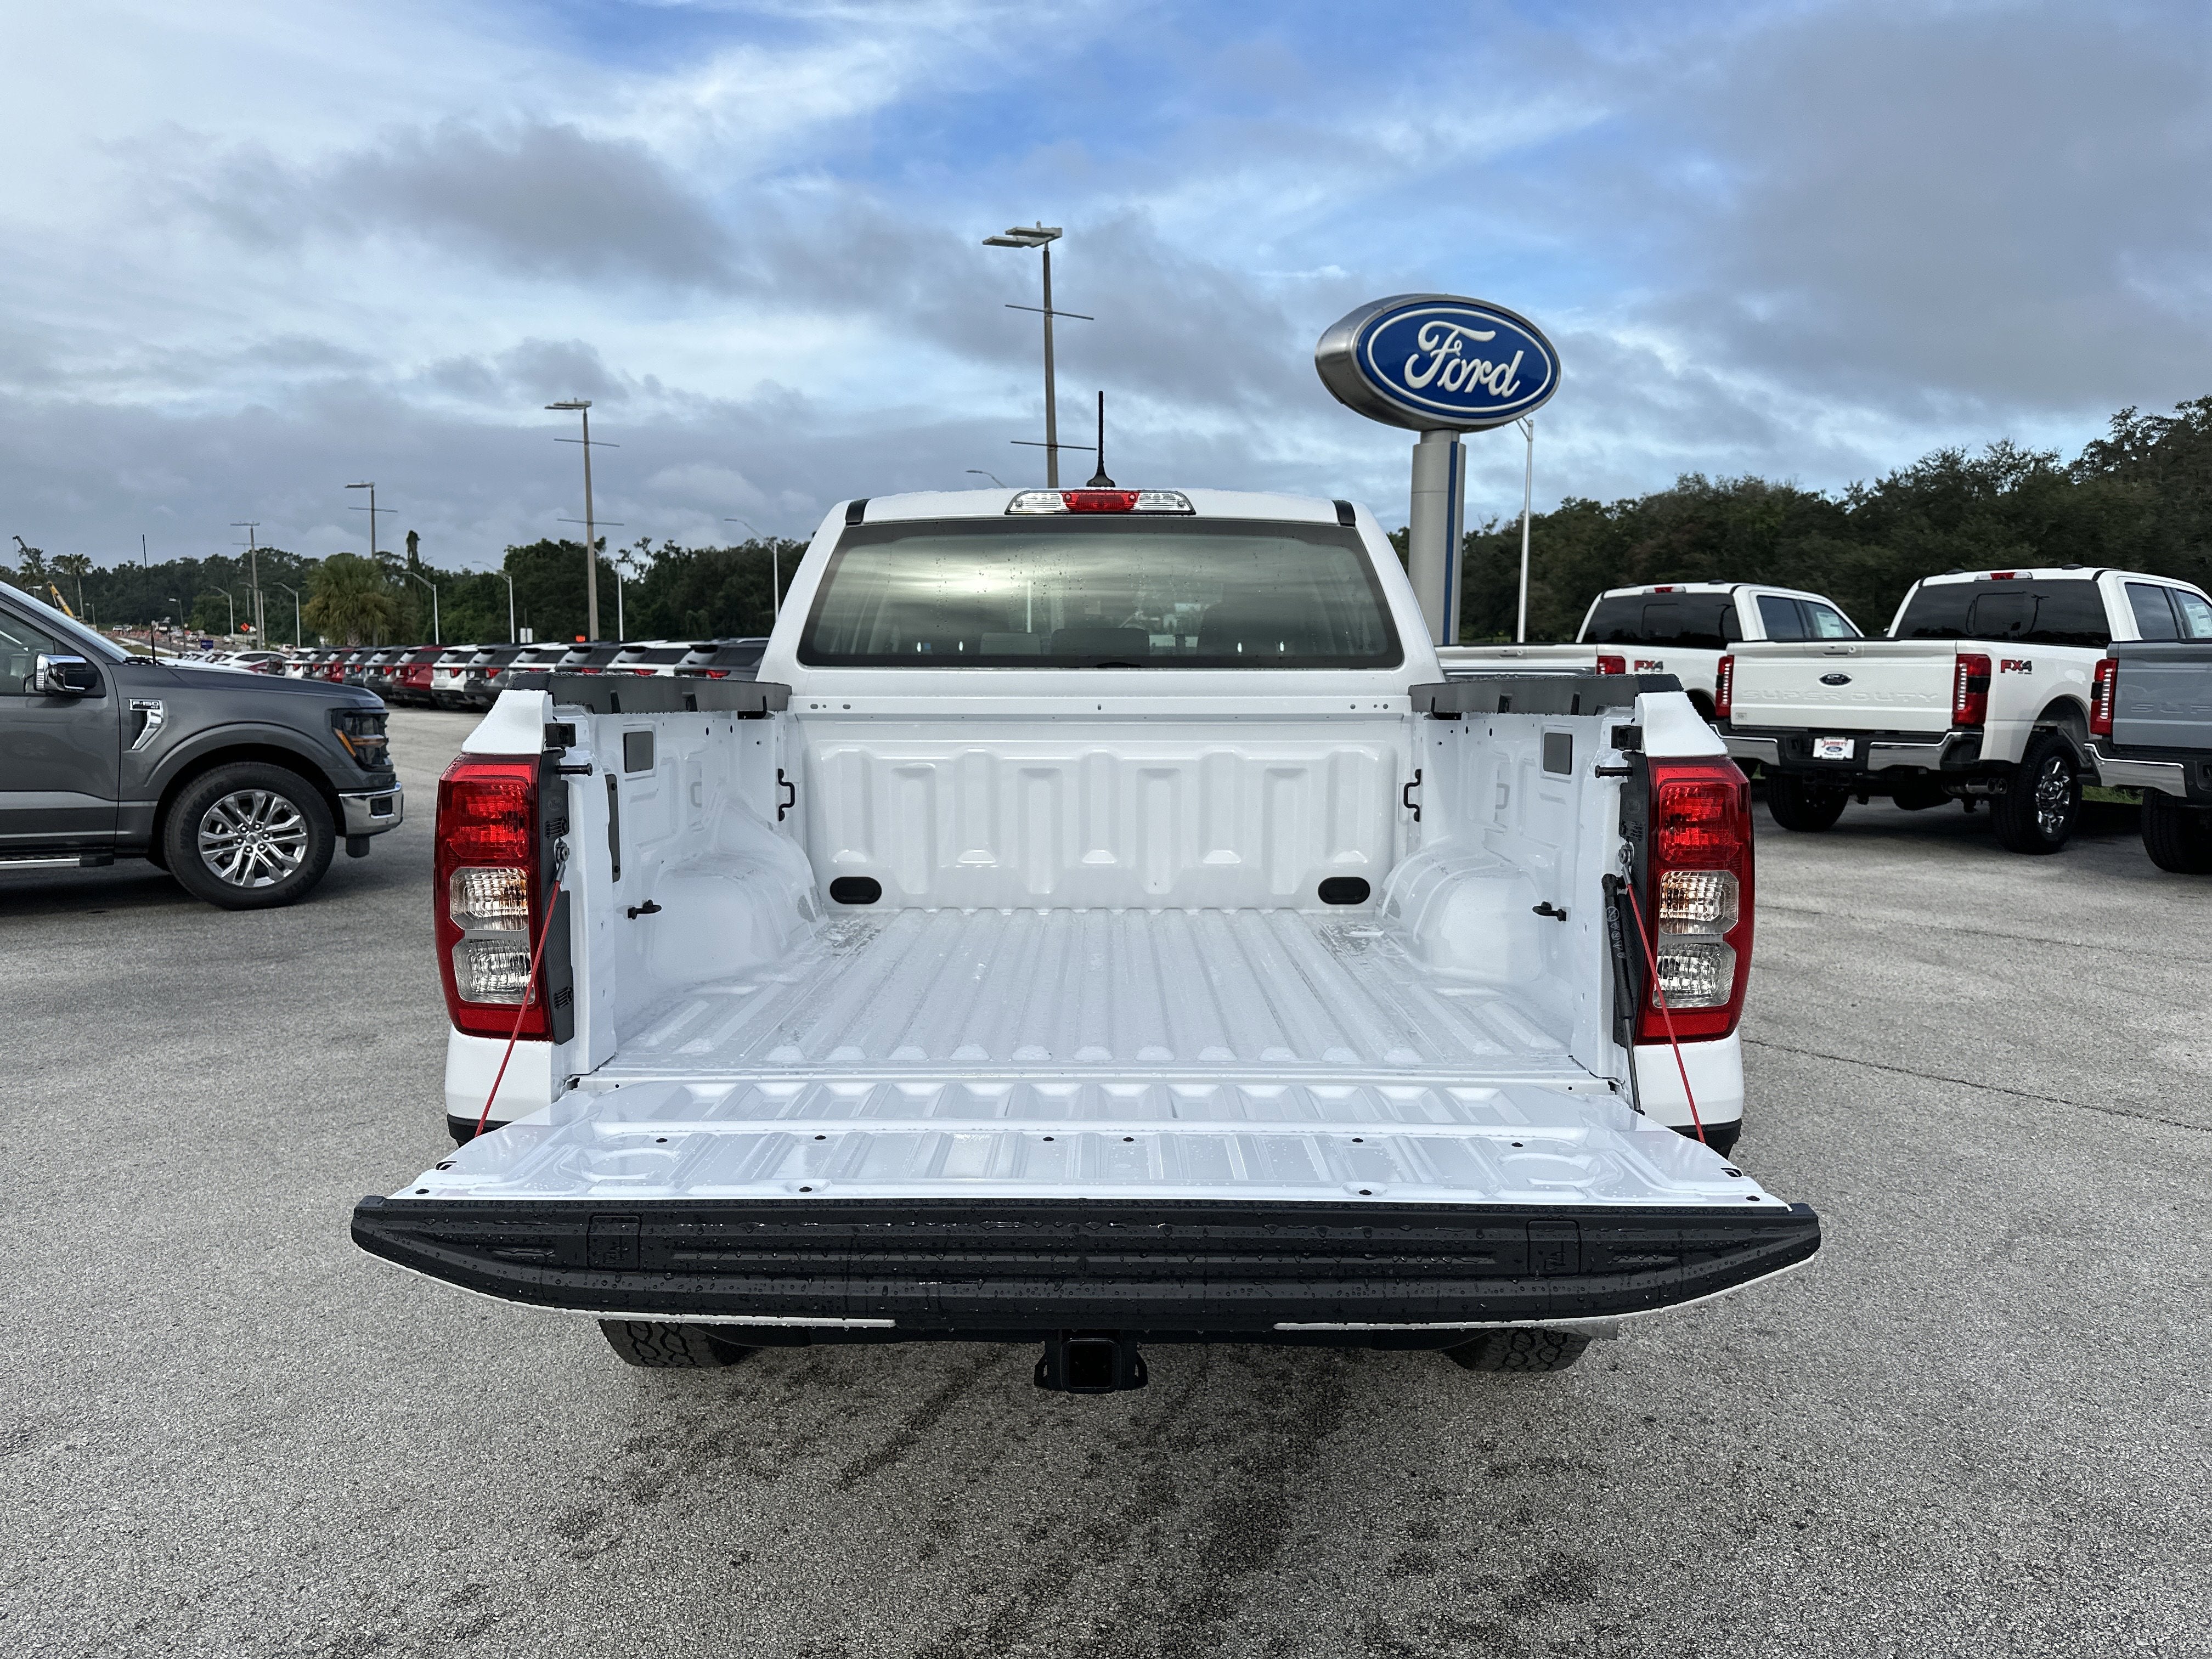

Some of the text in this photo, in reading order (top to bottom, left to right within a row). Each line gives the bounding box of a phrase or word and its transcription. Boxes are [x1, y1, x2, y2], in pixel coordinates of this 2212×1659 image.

[1404, 320, 1524, 398] Ford
[1634, 660, 1663, 672] FX4
[2001, 659, 2032, 673] FX4
[1742, 690, 1938, 703] SUPER DUTY
